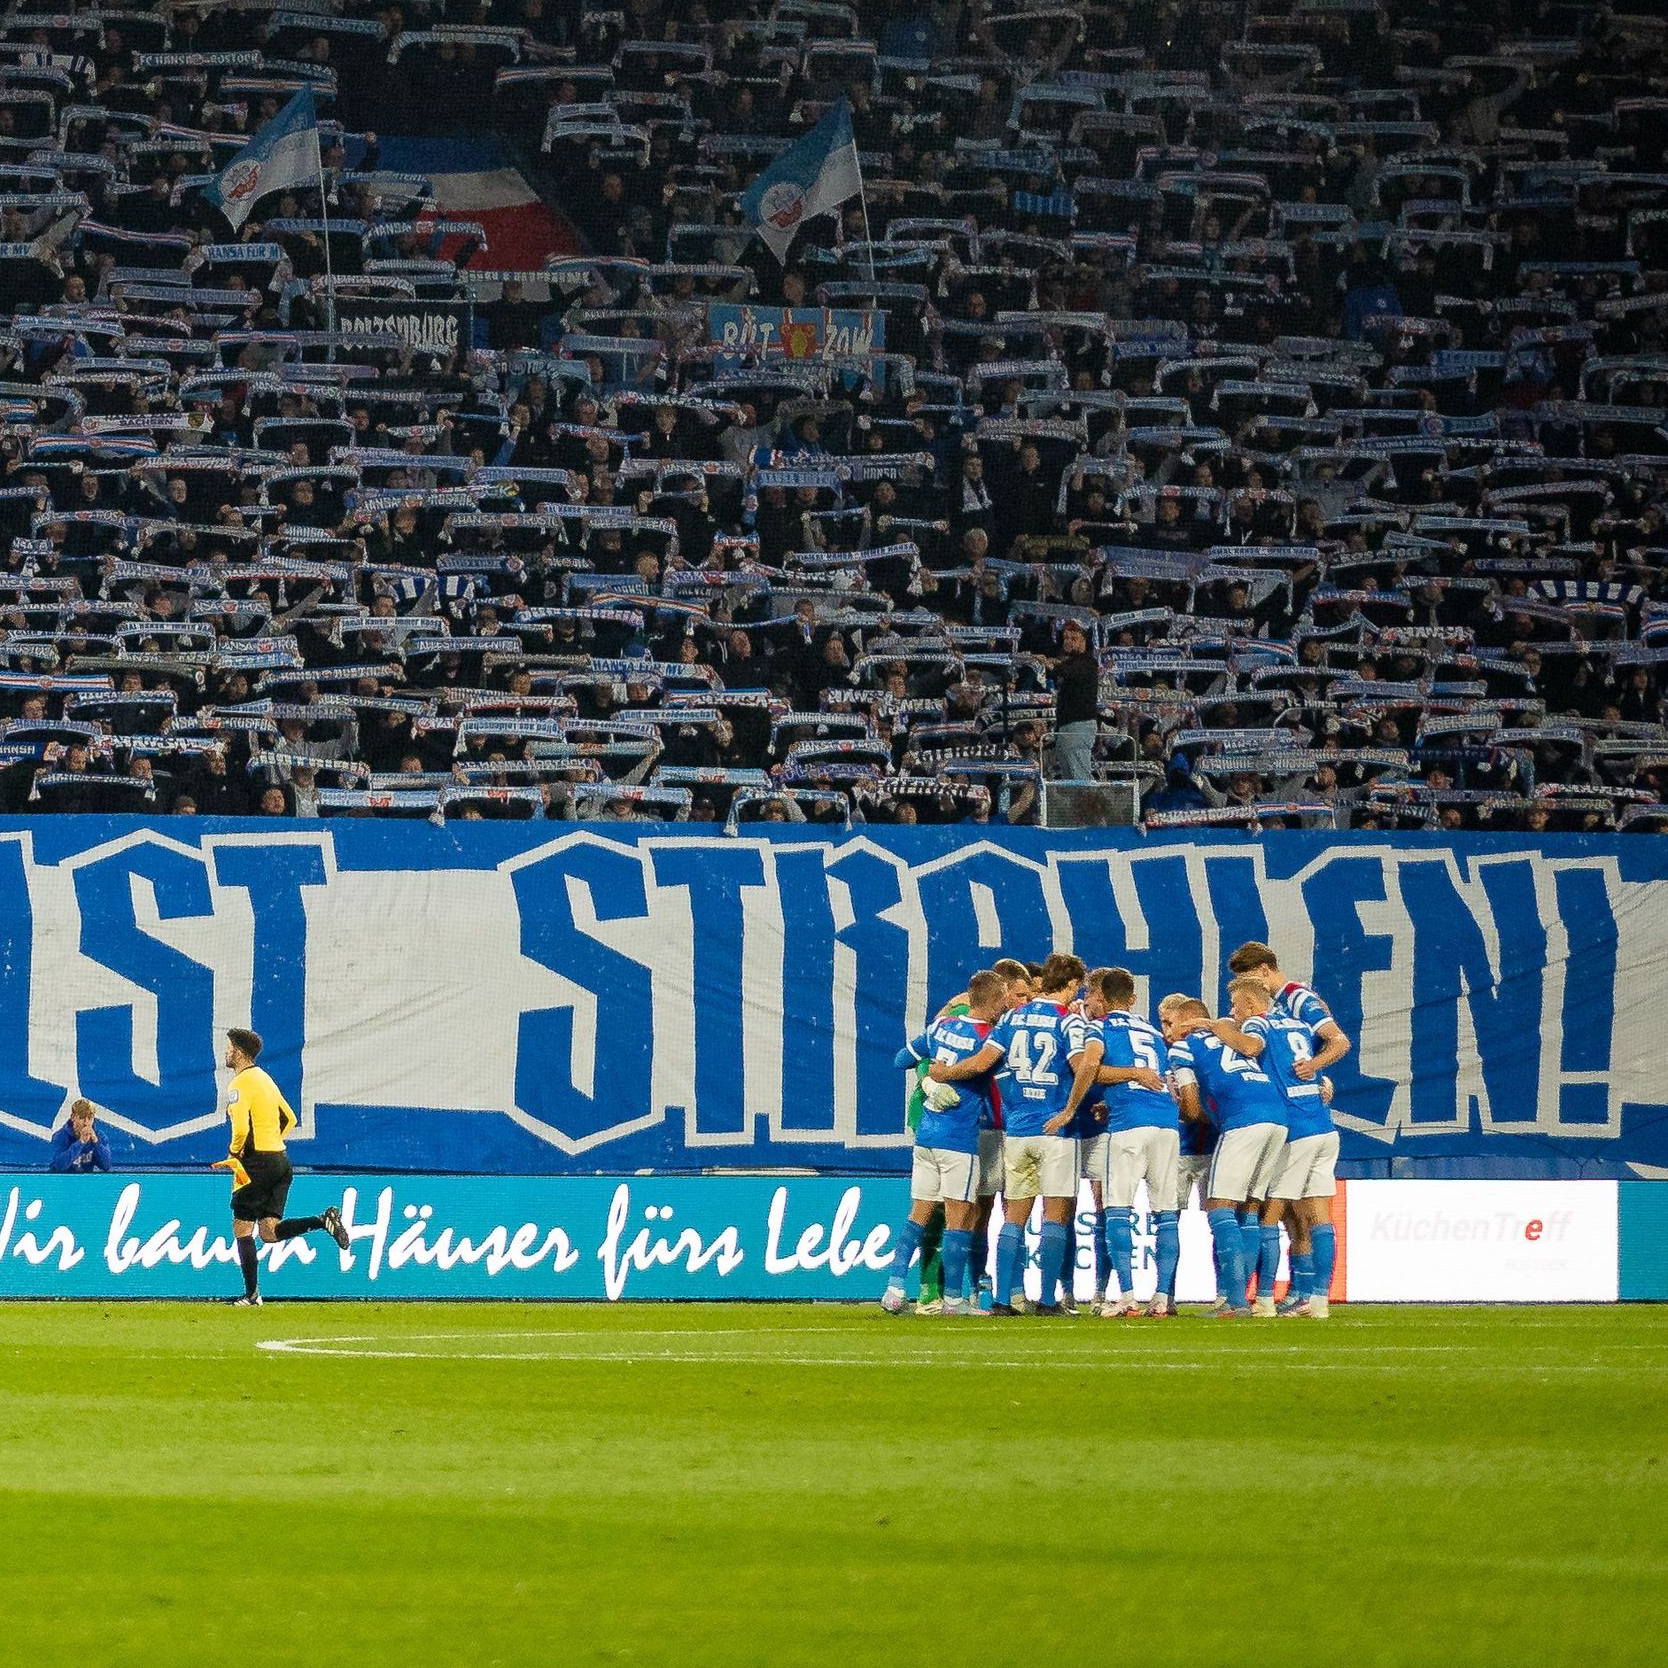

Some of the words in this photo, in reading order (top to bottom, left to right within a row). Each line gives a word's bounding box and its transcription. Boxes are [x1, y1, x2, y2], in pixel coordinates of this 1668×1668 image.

[1006, 1029, 1059, 1085] 42
[339, 1186, 579, 1280] Häuser
[598, 1183, 745, 1301] fürs
